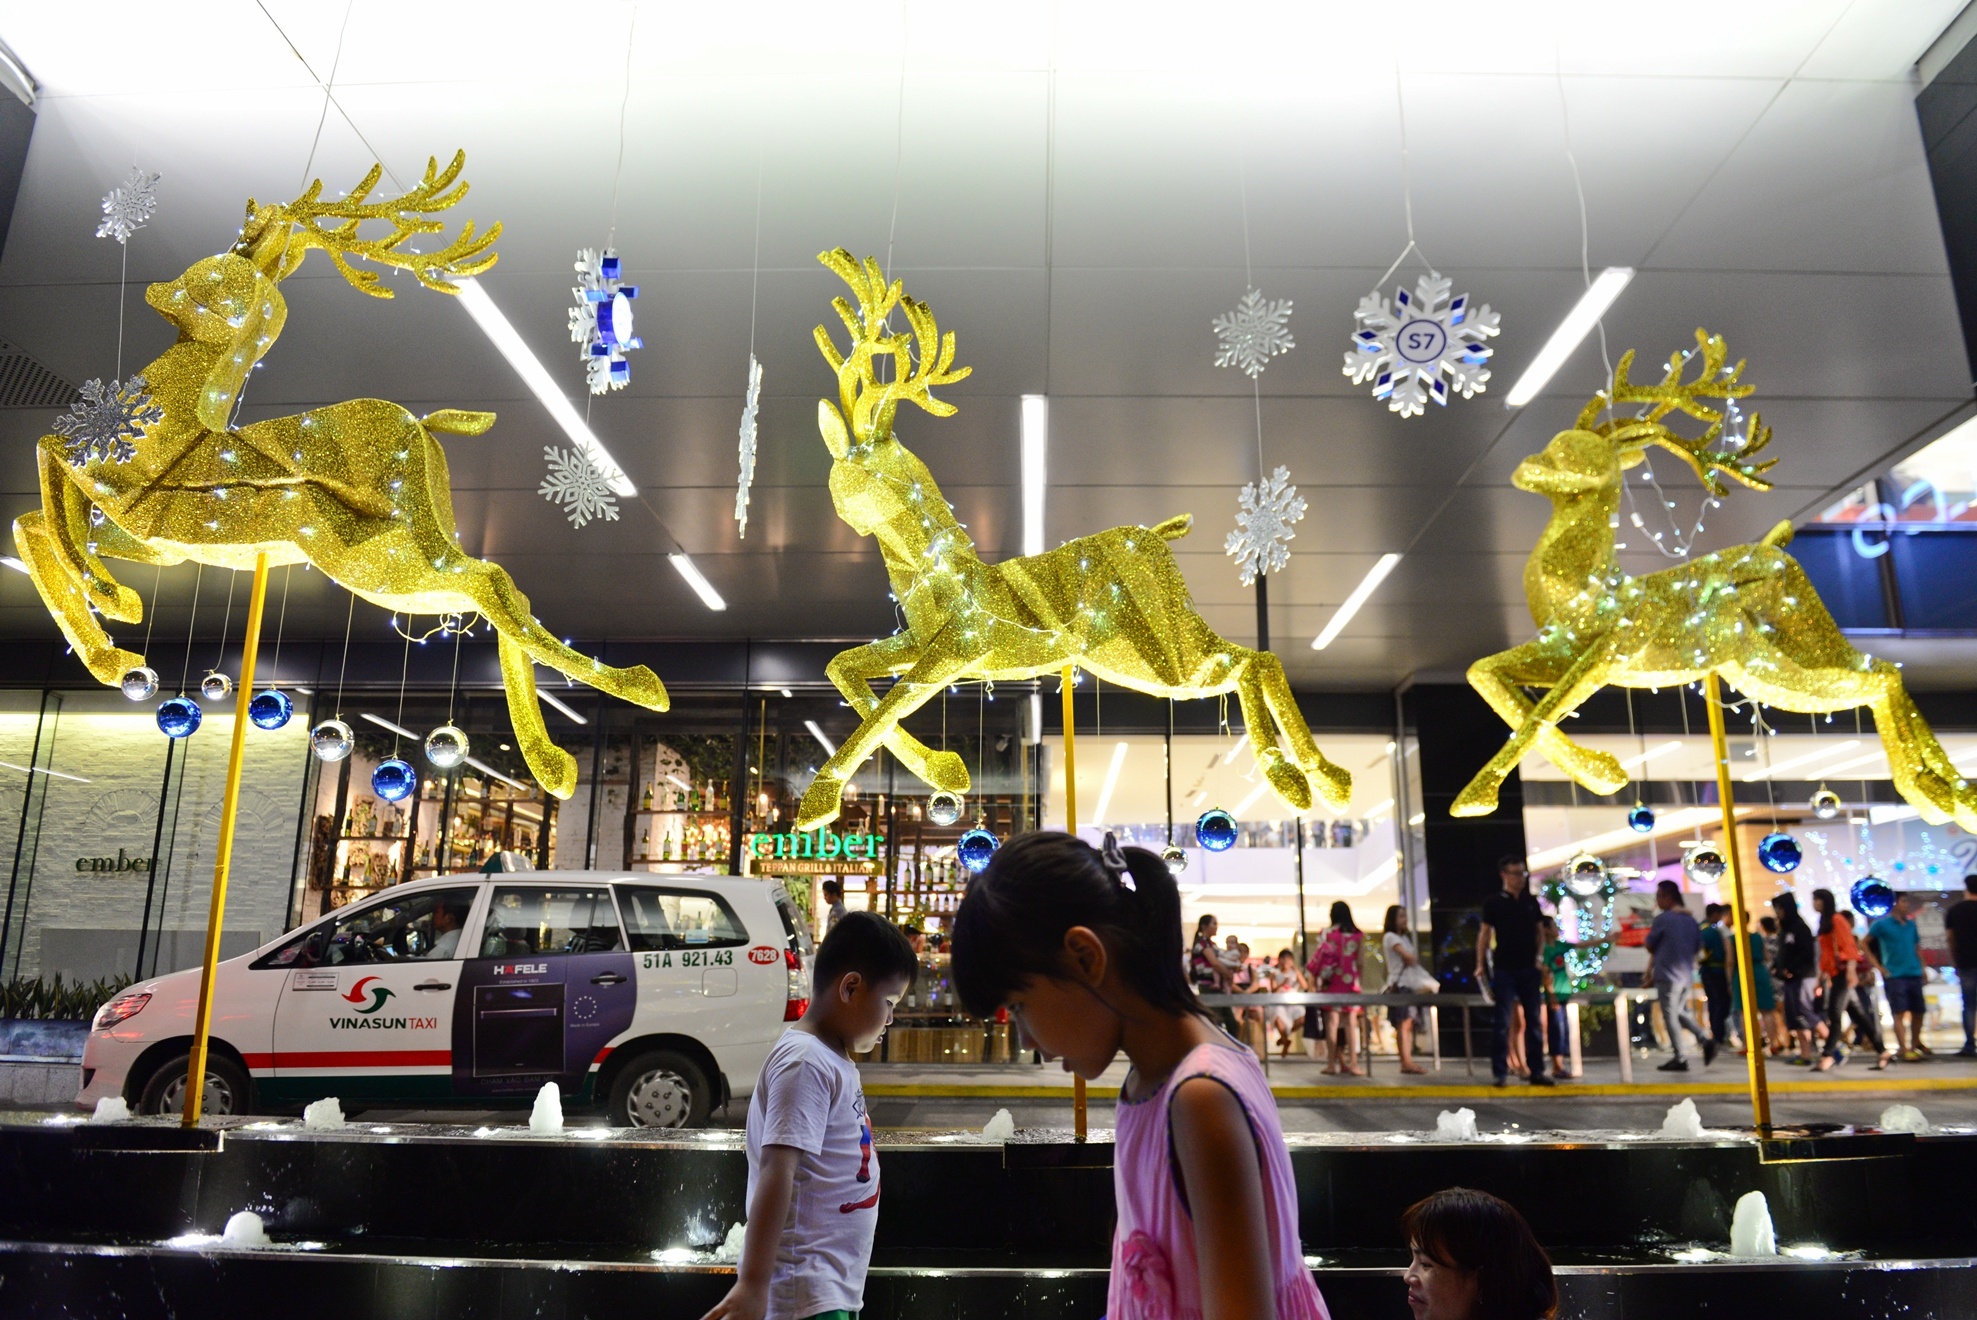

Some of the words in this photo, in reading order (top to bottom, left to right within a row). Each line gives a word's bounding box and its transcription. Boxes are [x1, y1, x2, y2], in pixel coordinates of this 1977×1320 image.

[1408, 333, 1435, 350] S7
[750, 825, 885, 859] ember
[760, 863, 797, 874] TEPPAN
[797, 863, 824, 873] GRILL
[833, 863, 873, 873] ITALIAN
[643, 952, 672, 968] 51A
[682, 950, 733, 967] 921.43
[750, 950, 777, 961] 7628
[329, 1018, 407, 1029] VINASUN
[408, 1017, 437, 1029] TAXI
